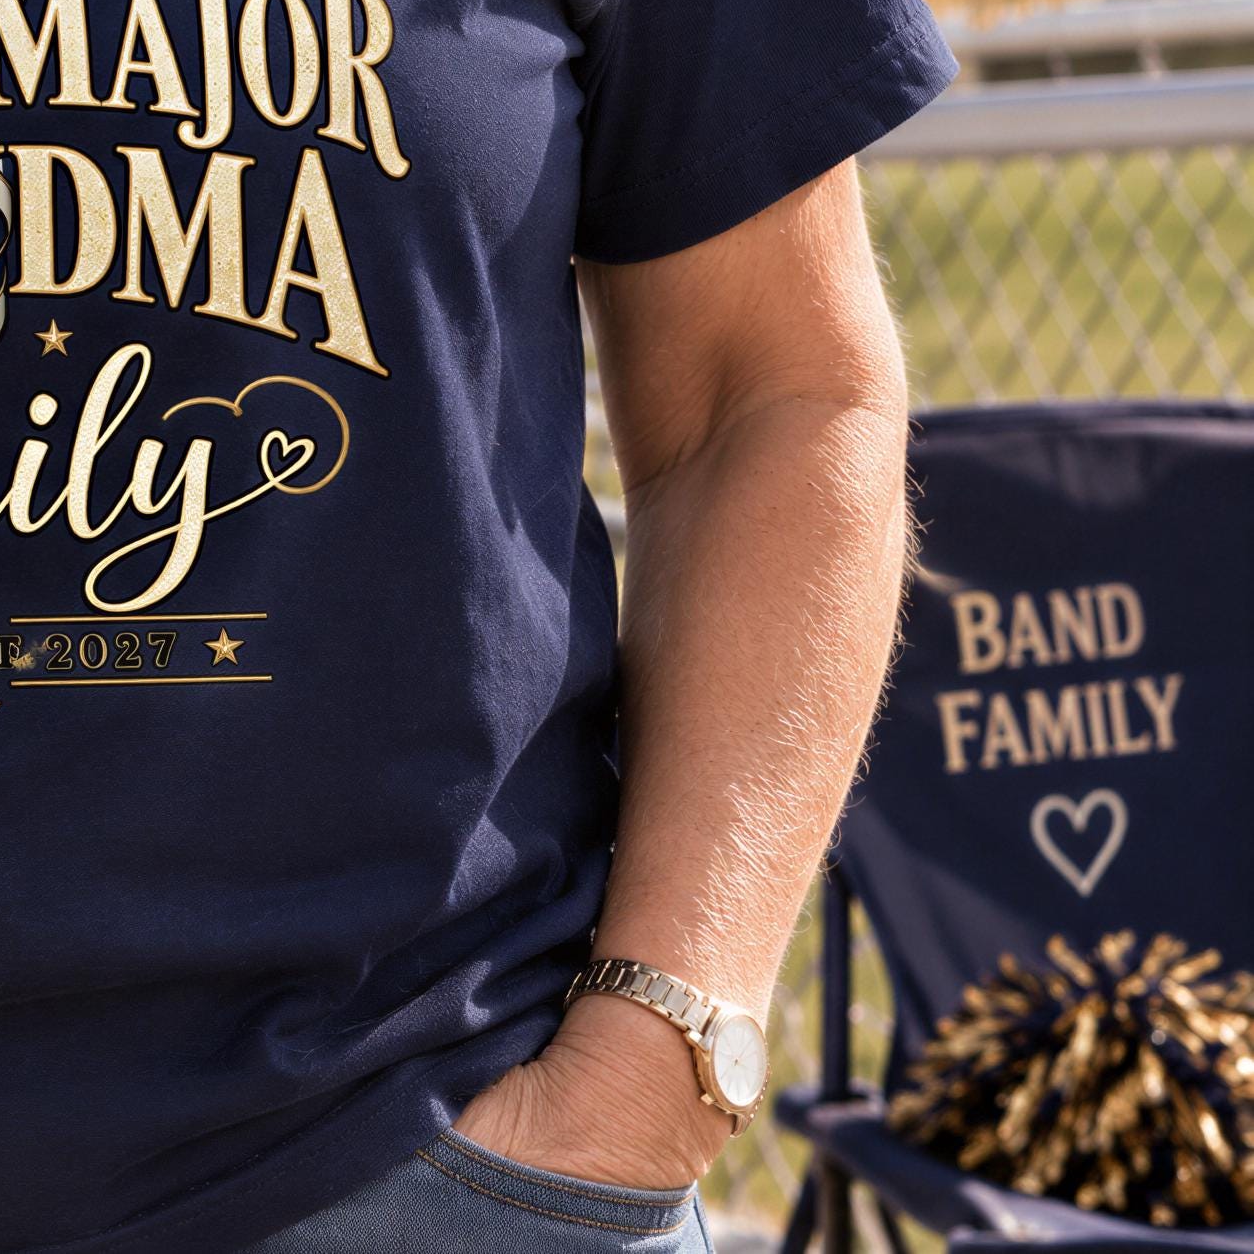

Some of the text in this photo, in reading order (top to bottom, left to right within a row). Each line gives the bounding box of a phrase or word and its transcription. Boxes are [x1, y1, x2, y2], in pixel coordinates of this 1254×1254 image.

[45, 631, 177, 672] 2027
[949, 582, 1146, 676] BAND
[935, 673, 1184, 774] FAMILY
